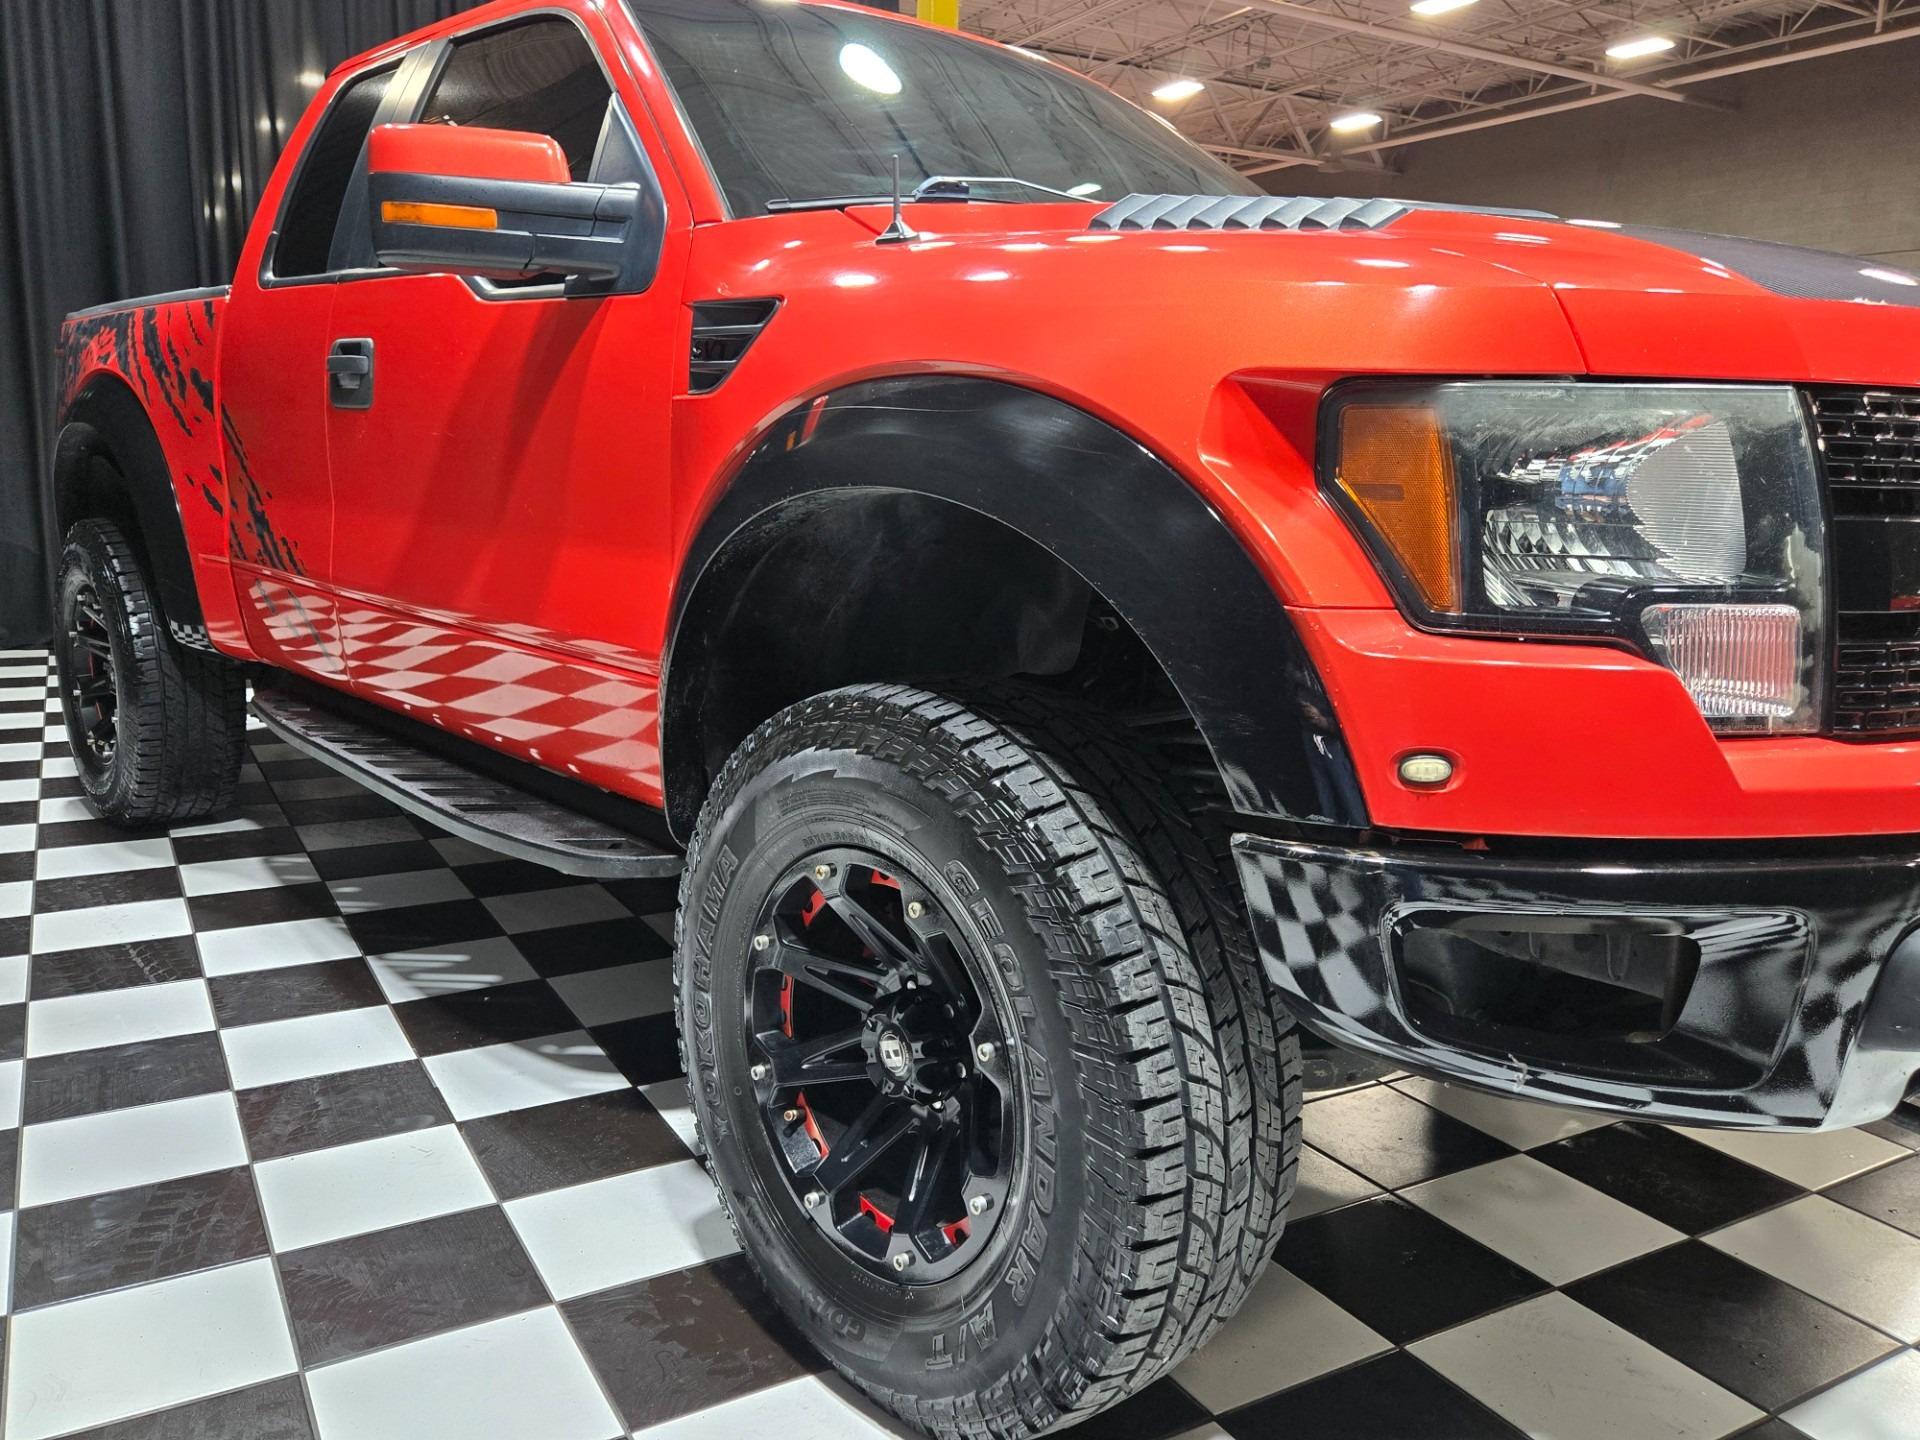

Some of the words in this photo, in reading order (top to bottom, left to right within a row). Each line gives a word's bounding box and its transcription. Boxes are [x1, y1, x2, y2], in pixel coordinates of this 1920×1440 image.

[692, 844, 738, 1145] YOKOHAMA
[944, 861, 1059, 1305] GEOLANDAR
[926, 1300, 997, 1370] A/T
